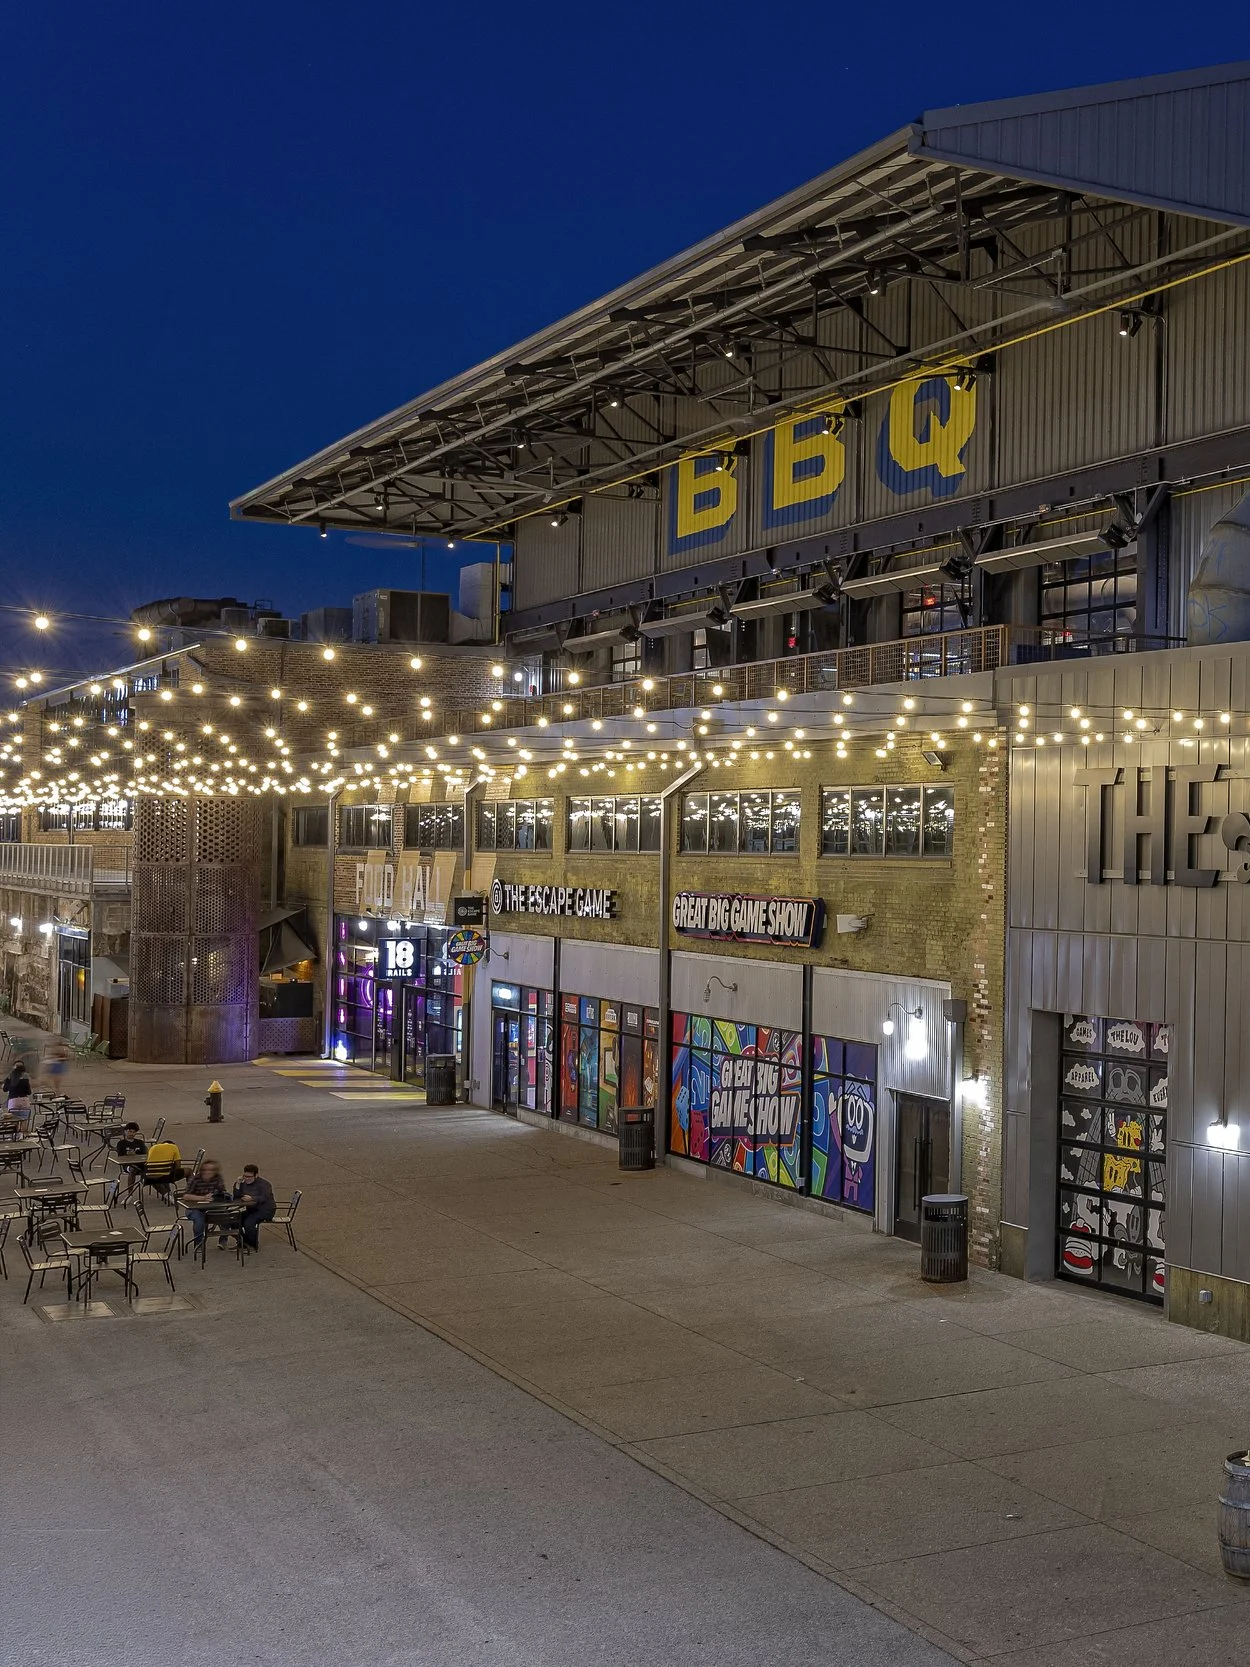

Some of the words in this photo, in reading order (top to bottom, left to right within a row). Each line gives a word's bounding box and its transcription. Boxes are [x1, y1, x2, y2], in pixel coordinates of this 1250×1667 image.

[671, 353, 977, 552] BBQ
[1072, 763, 1222, 889] THE
[355, 863, 394, 907] FOOD
[504, 884, 526, 912] THE
[528, 885, 573, 917] ESCAPE
[575, 888, 612, 920] GAME
[672, 895, 708, 930] GREAT
[708, 897, 730, 932] BIG
[730, 899, 767, 935] GAME
[768, 900, 810, 938] SHOW
[386, 940, 415, 969] 18
[386, 968, 413, 977] RAILS
[1075, 1027, 1093, 1038] GAMES
[1110, 1030, 1125, 1044] THE
[1125, 1031, 1139, 1047] LOU
[720, 1059, 754, 1090] GREAT
[754, 1057, 779, 1095] BIG
[1070, 1072, 1096, 1084] APPAREL
[711, 1086, 750, 1129] GAME
[749, 1095, 797, 1136] SHOW
